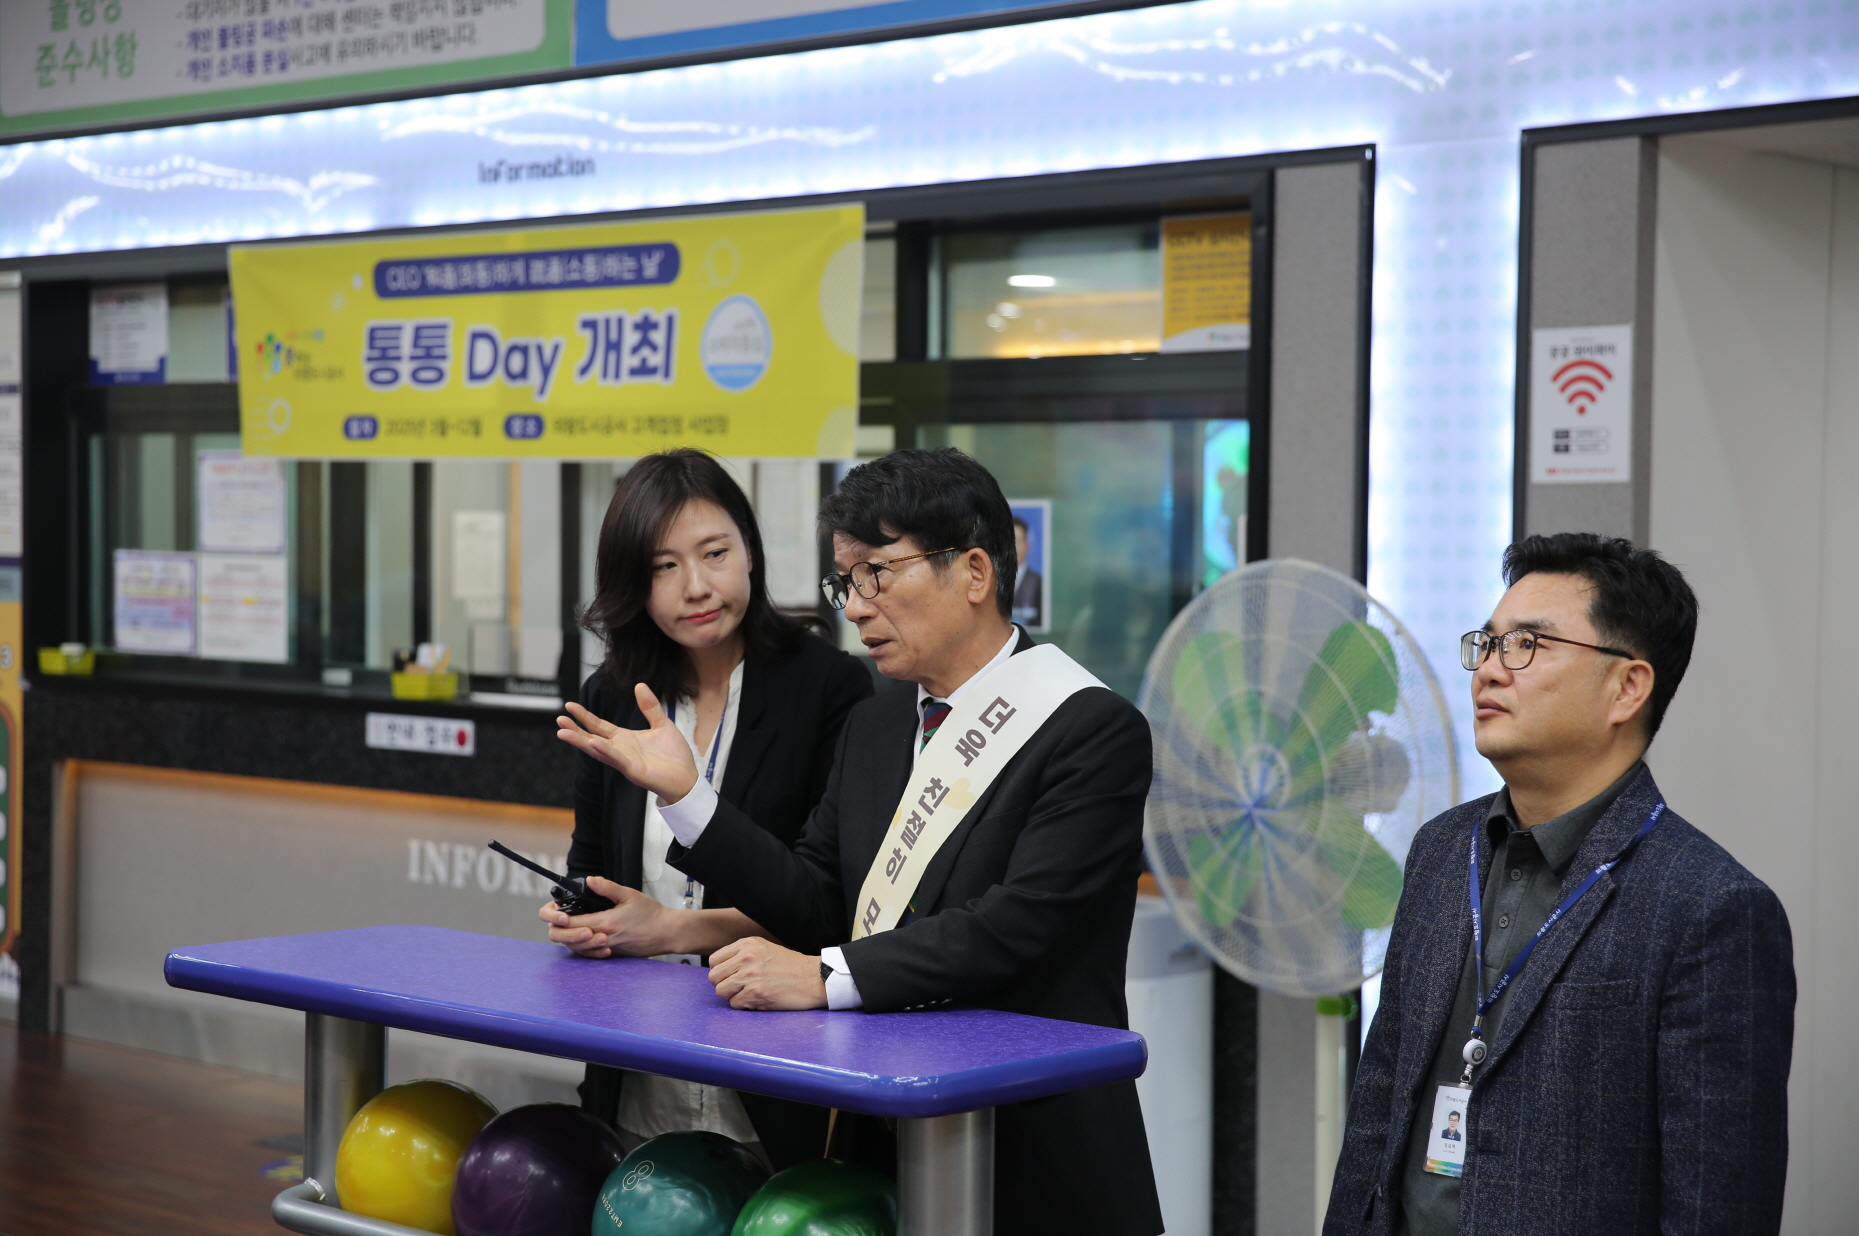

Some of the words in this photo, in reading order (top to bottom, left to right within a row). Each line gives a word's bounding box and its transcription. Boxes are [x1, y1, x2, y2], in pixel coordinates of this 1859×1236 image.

[36, 30, 138, 88] 준수사항
[364, 322, 449, 388] 통통
[467, 330, 562, 397] Day
[578, 313, 678, 383] 개최
[954, 696, 1017, 767] 더욱
[885, 777, 950, 885] 친절히
[861, 897, 882, 939] 모
[1487, 973, 1510, 1004] 의왕도시공사
